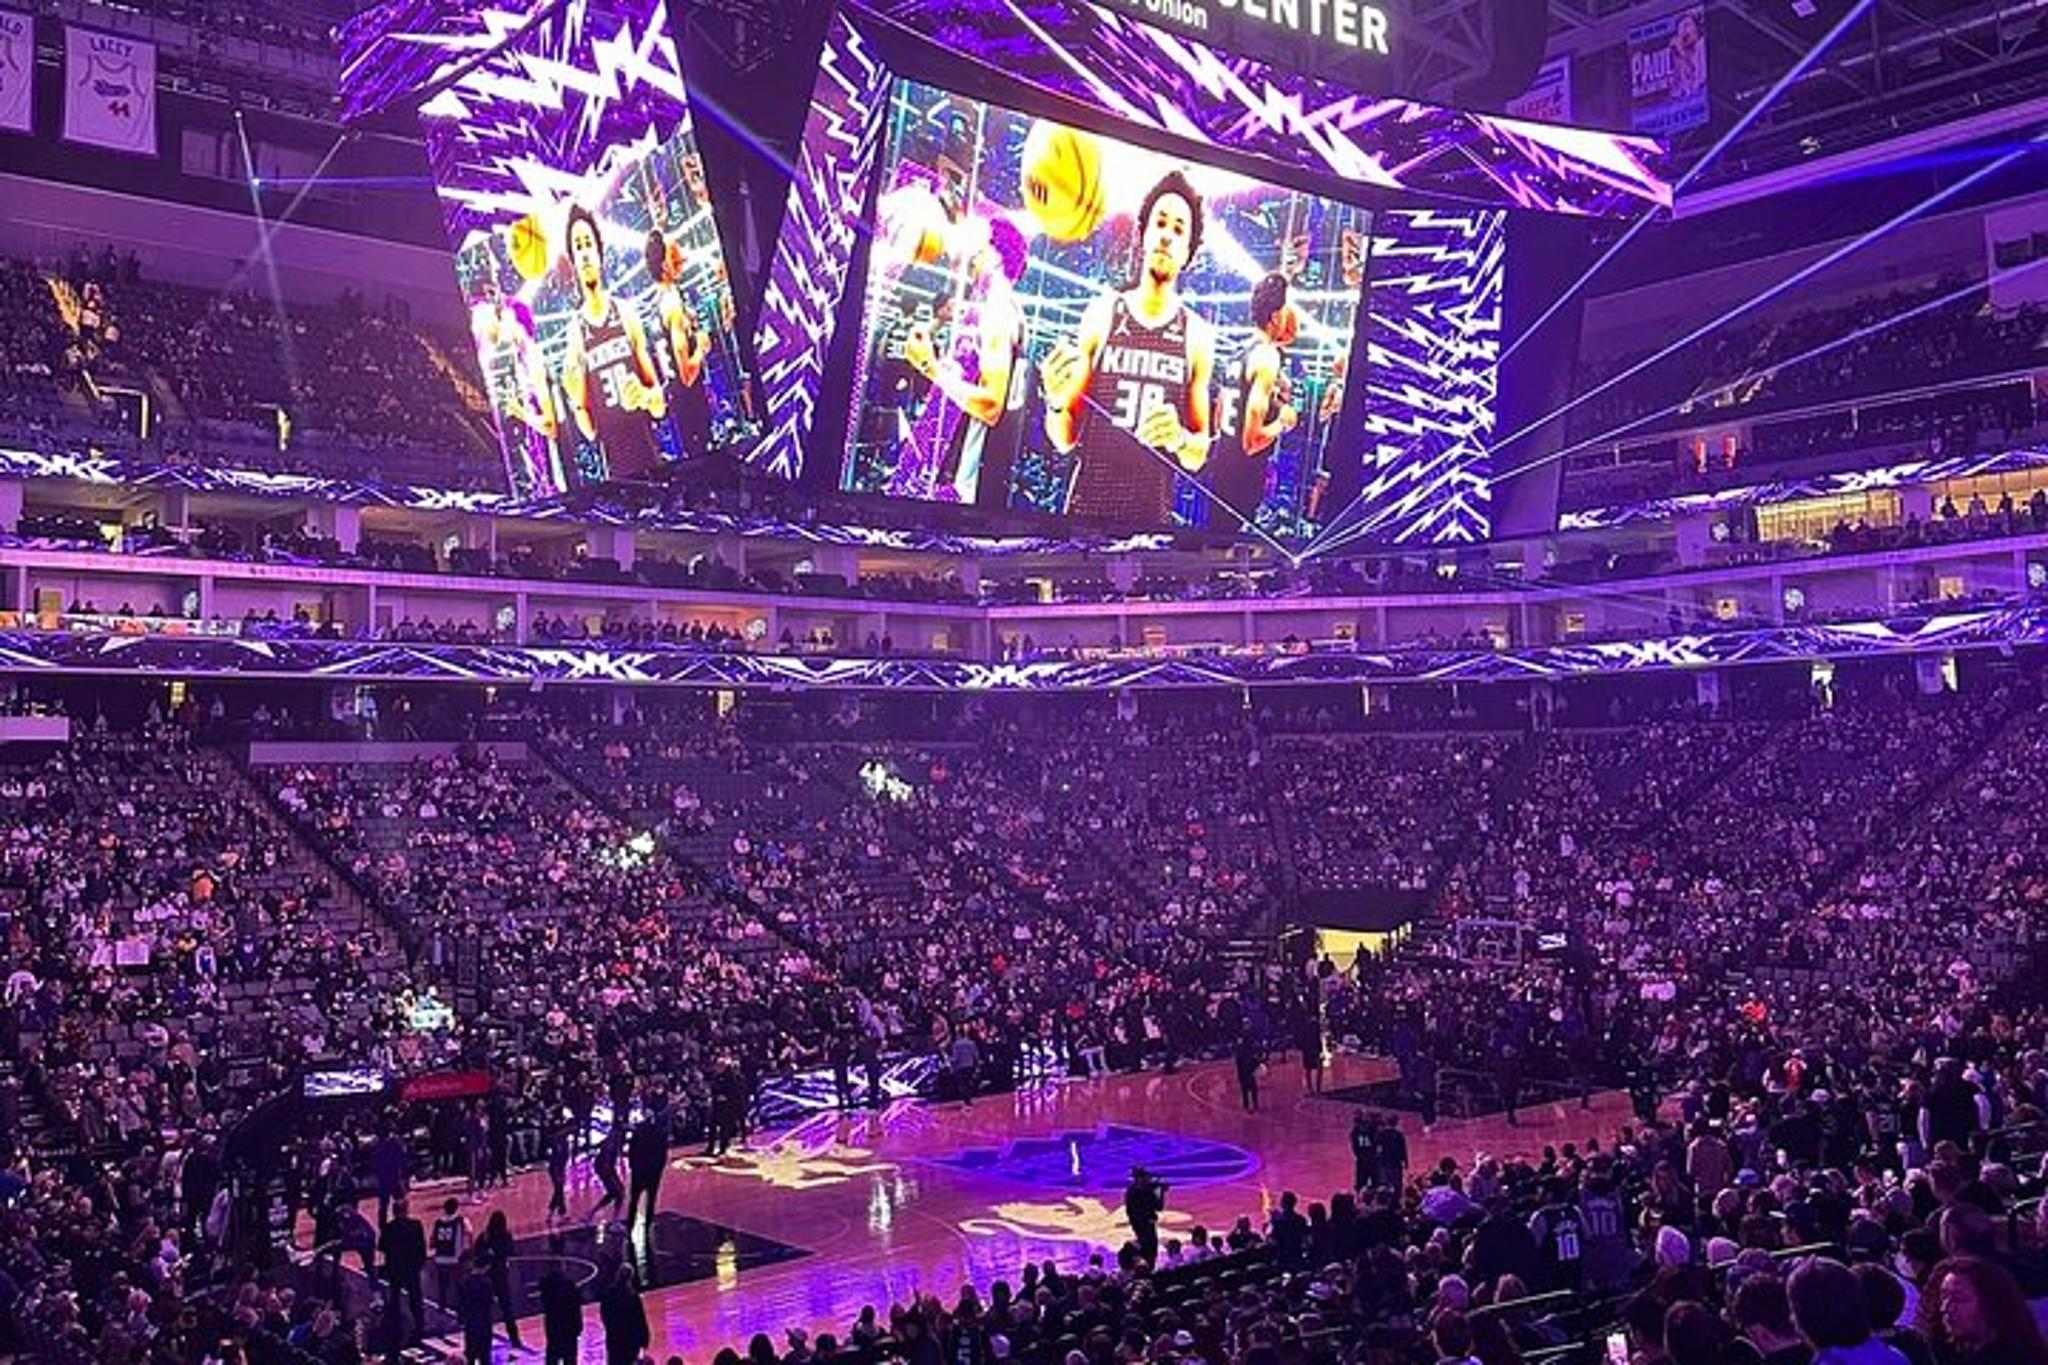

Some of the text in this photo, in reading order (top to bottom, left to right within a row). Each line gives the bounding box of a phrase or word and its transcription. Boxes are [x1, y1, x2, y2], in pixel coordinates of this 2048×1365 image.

[1219, 0, 1389, 54] NTER
[1631, 47, 1674, 84] PAUL
[108, 101, 130, 117] 44
[1101, 344, 1185, 383] KINGS
[1556, 1231, 1580, 1261] 10
